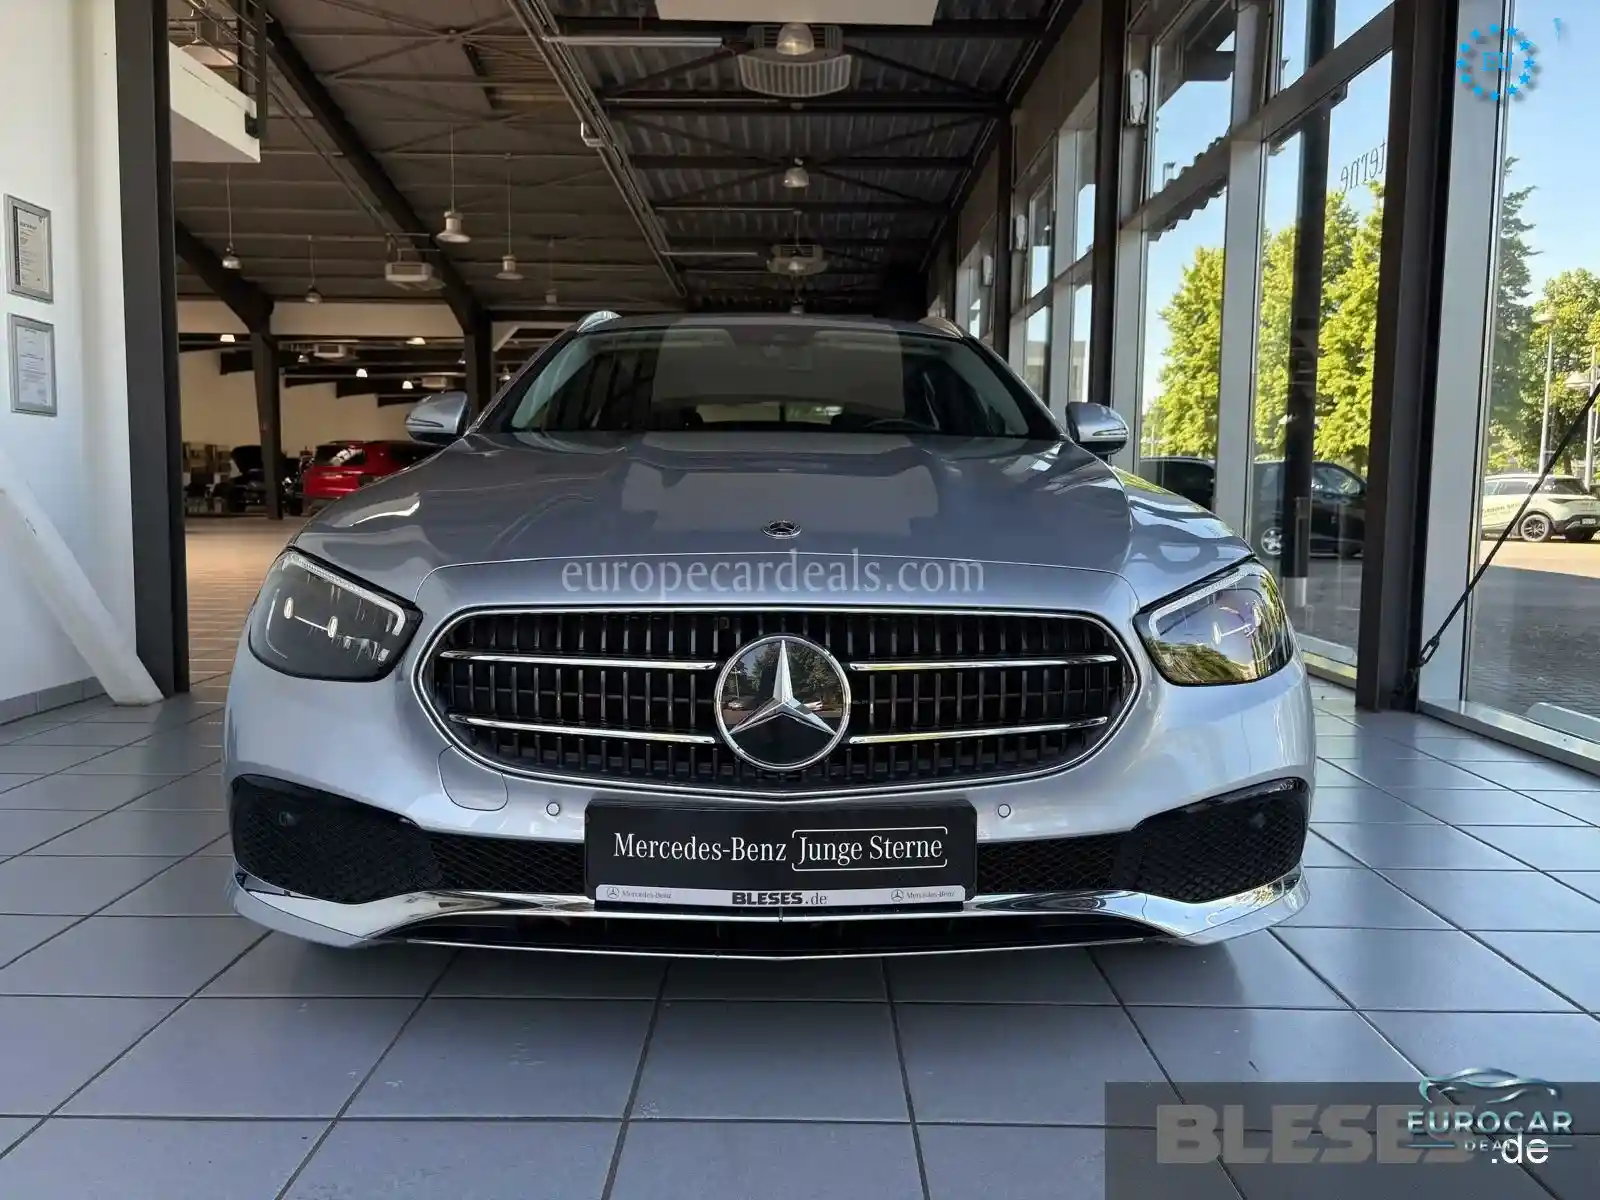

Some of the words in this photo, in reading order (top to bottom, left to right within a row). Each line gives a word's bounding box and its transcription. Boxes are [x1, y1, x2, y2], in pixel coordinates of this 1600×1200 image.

[613, 832, 787, 862] Mercedes-Benz
[798, 836, 863, 866] Junge
[869, 835, 943, 860] Sterne
